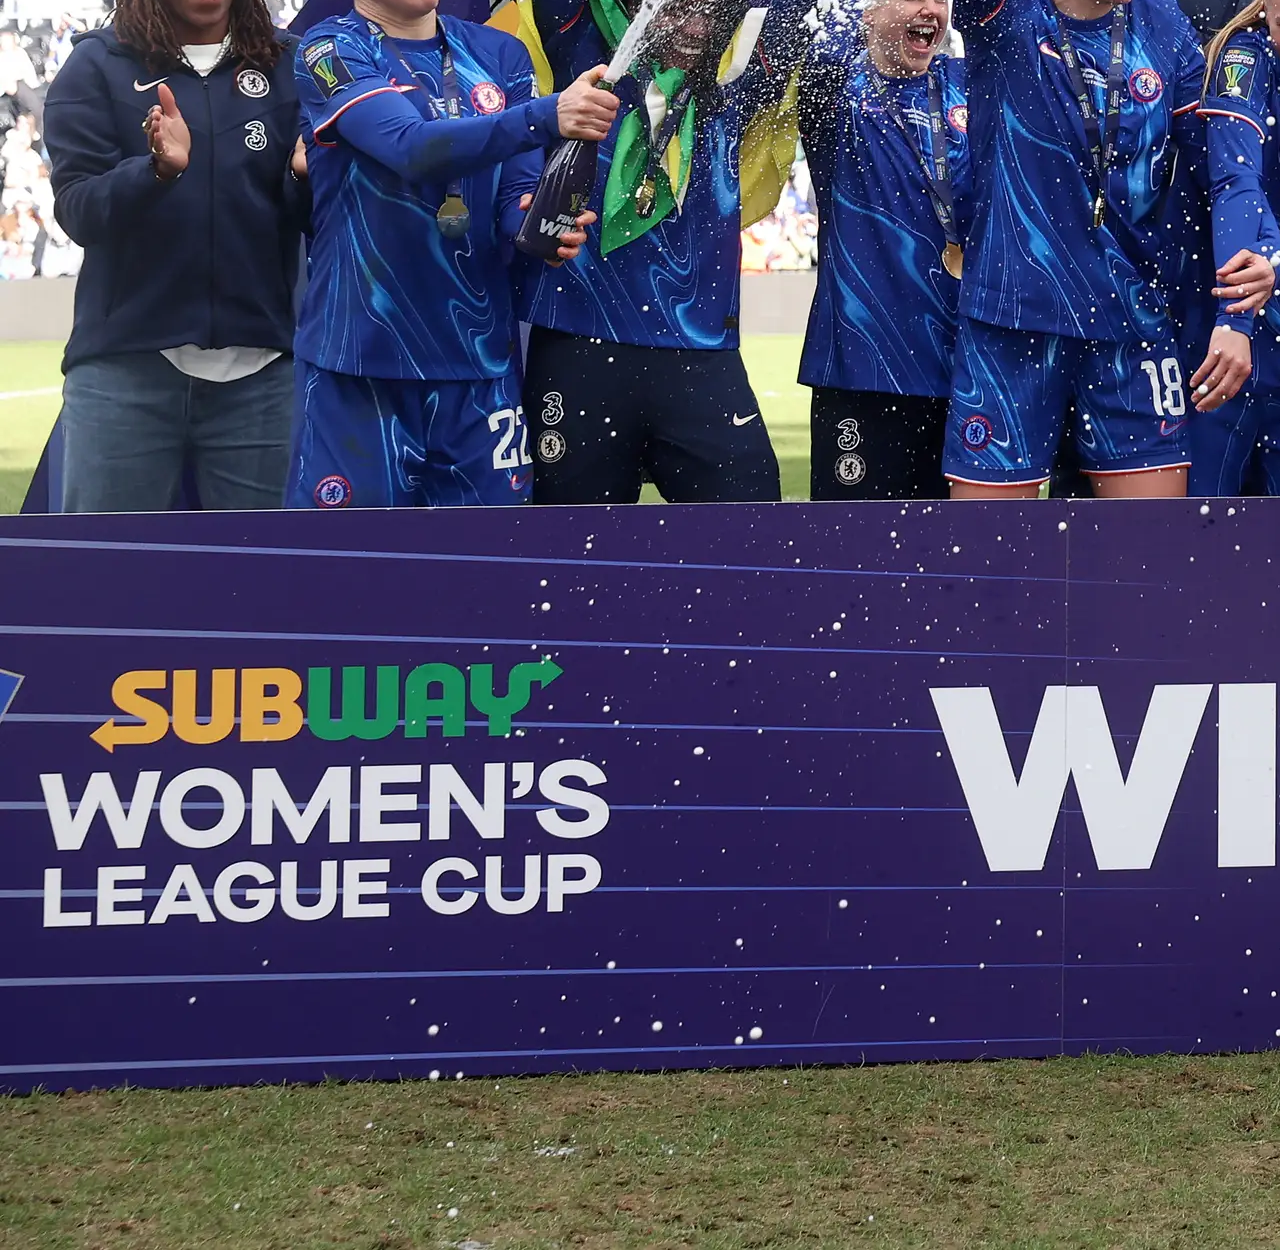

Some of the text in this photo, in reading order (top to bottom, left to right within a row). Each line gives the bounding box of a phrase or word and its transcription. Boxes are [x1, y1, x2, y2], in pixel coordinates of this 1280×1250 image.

[556, 213, 578, 226] FINA
[1140, 357, 1186, 416] 18
[89, 655, 564, 754] SUBWAY
[39, 759, 611, 851] WOMEN'S
[42, 853, 603, 928] LEAGUE CUP
